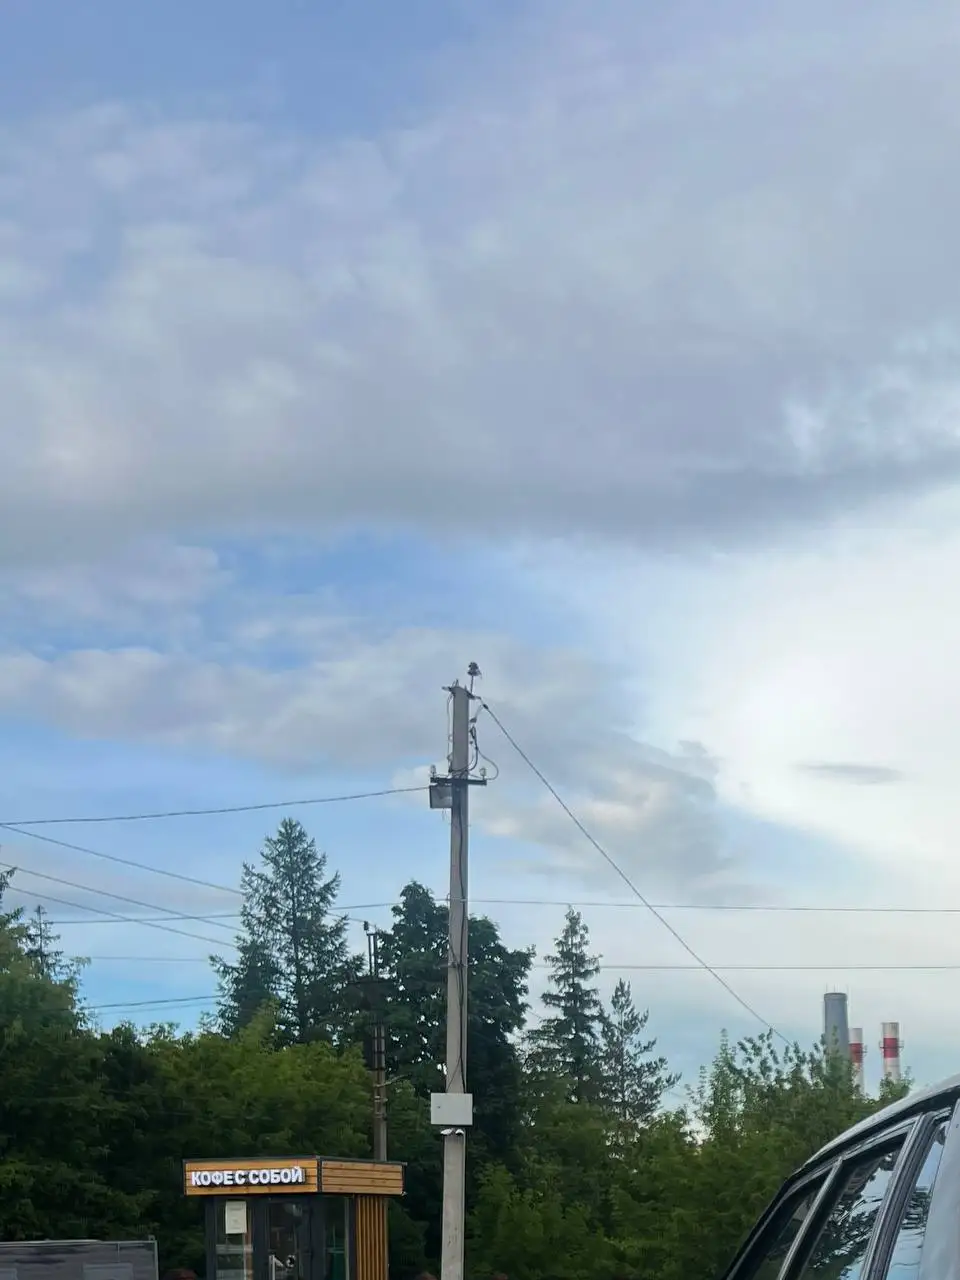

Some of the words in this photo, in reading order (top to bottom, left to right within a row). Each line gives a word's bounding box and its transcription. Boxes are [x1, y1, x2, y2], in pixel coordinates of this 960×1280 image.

[191, 1170, 233, 1187] КОФЕ
[235, 1170, 246, 1185] С
[248, 1166, 303, 1184] СОБОЙ
